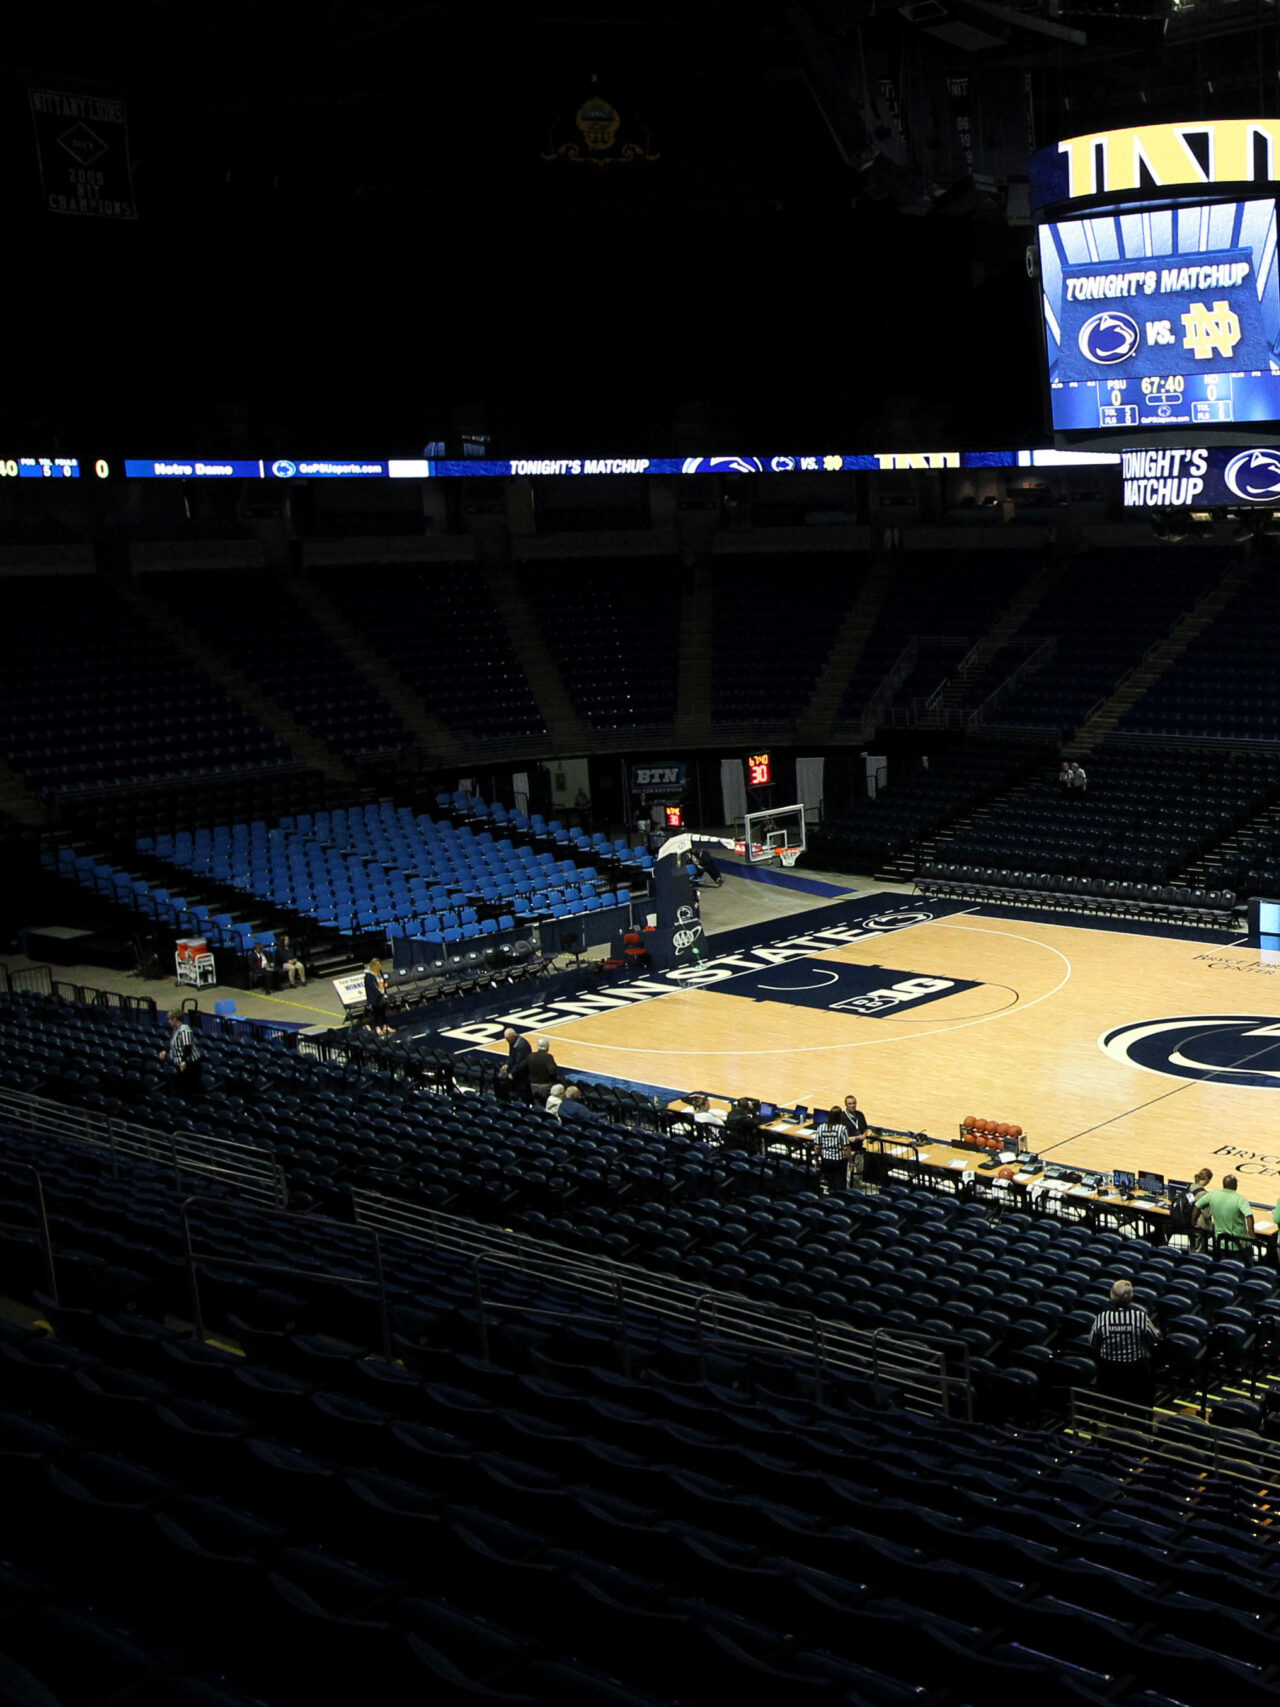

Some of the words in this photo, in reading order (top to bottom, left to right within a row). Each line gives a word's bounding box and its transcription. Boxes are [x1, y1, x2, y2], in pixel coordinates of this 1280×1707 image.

[1066, 271, 1157, 300] TONIGHT'S
[1160, 262, 1250, 293] MATCHUP
[1145, 320, 1176, 346] VS.
[1141, 375, 1185, 394] 67:40
[1207, 384, 1217, 401] 0
[1111, 389, 1122, 406] 0
[95, 459, 109, 479] 0
[154, 463, 192, 476] Notre
[195, 463, 233, 476] Dame
[510, 460, 582, 476] TONIGHT'S
[584, 458, 650, 475] MATCHUP
[800, 456, 818, 471] VS.
[1122, 449, 1209, 479] TONIGHT'S
[1124, 477, 1205, 506] MATCHUP
[636, 768, 679, 784] BTN
[752, 765, 768, 784] 30
[440, 980, 684, 1042] PENN
[668, 925, 868, 985] STATE
